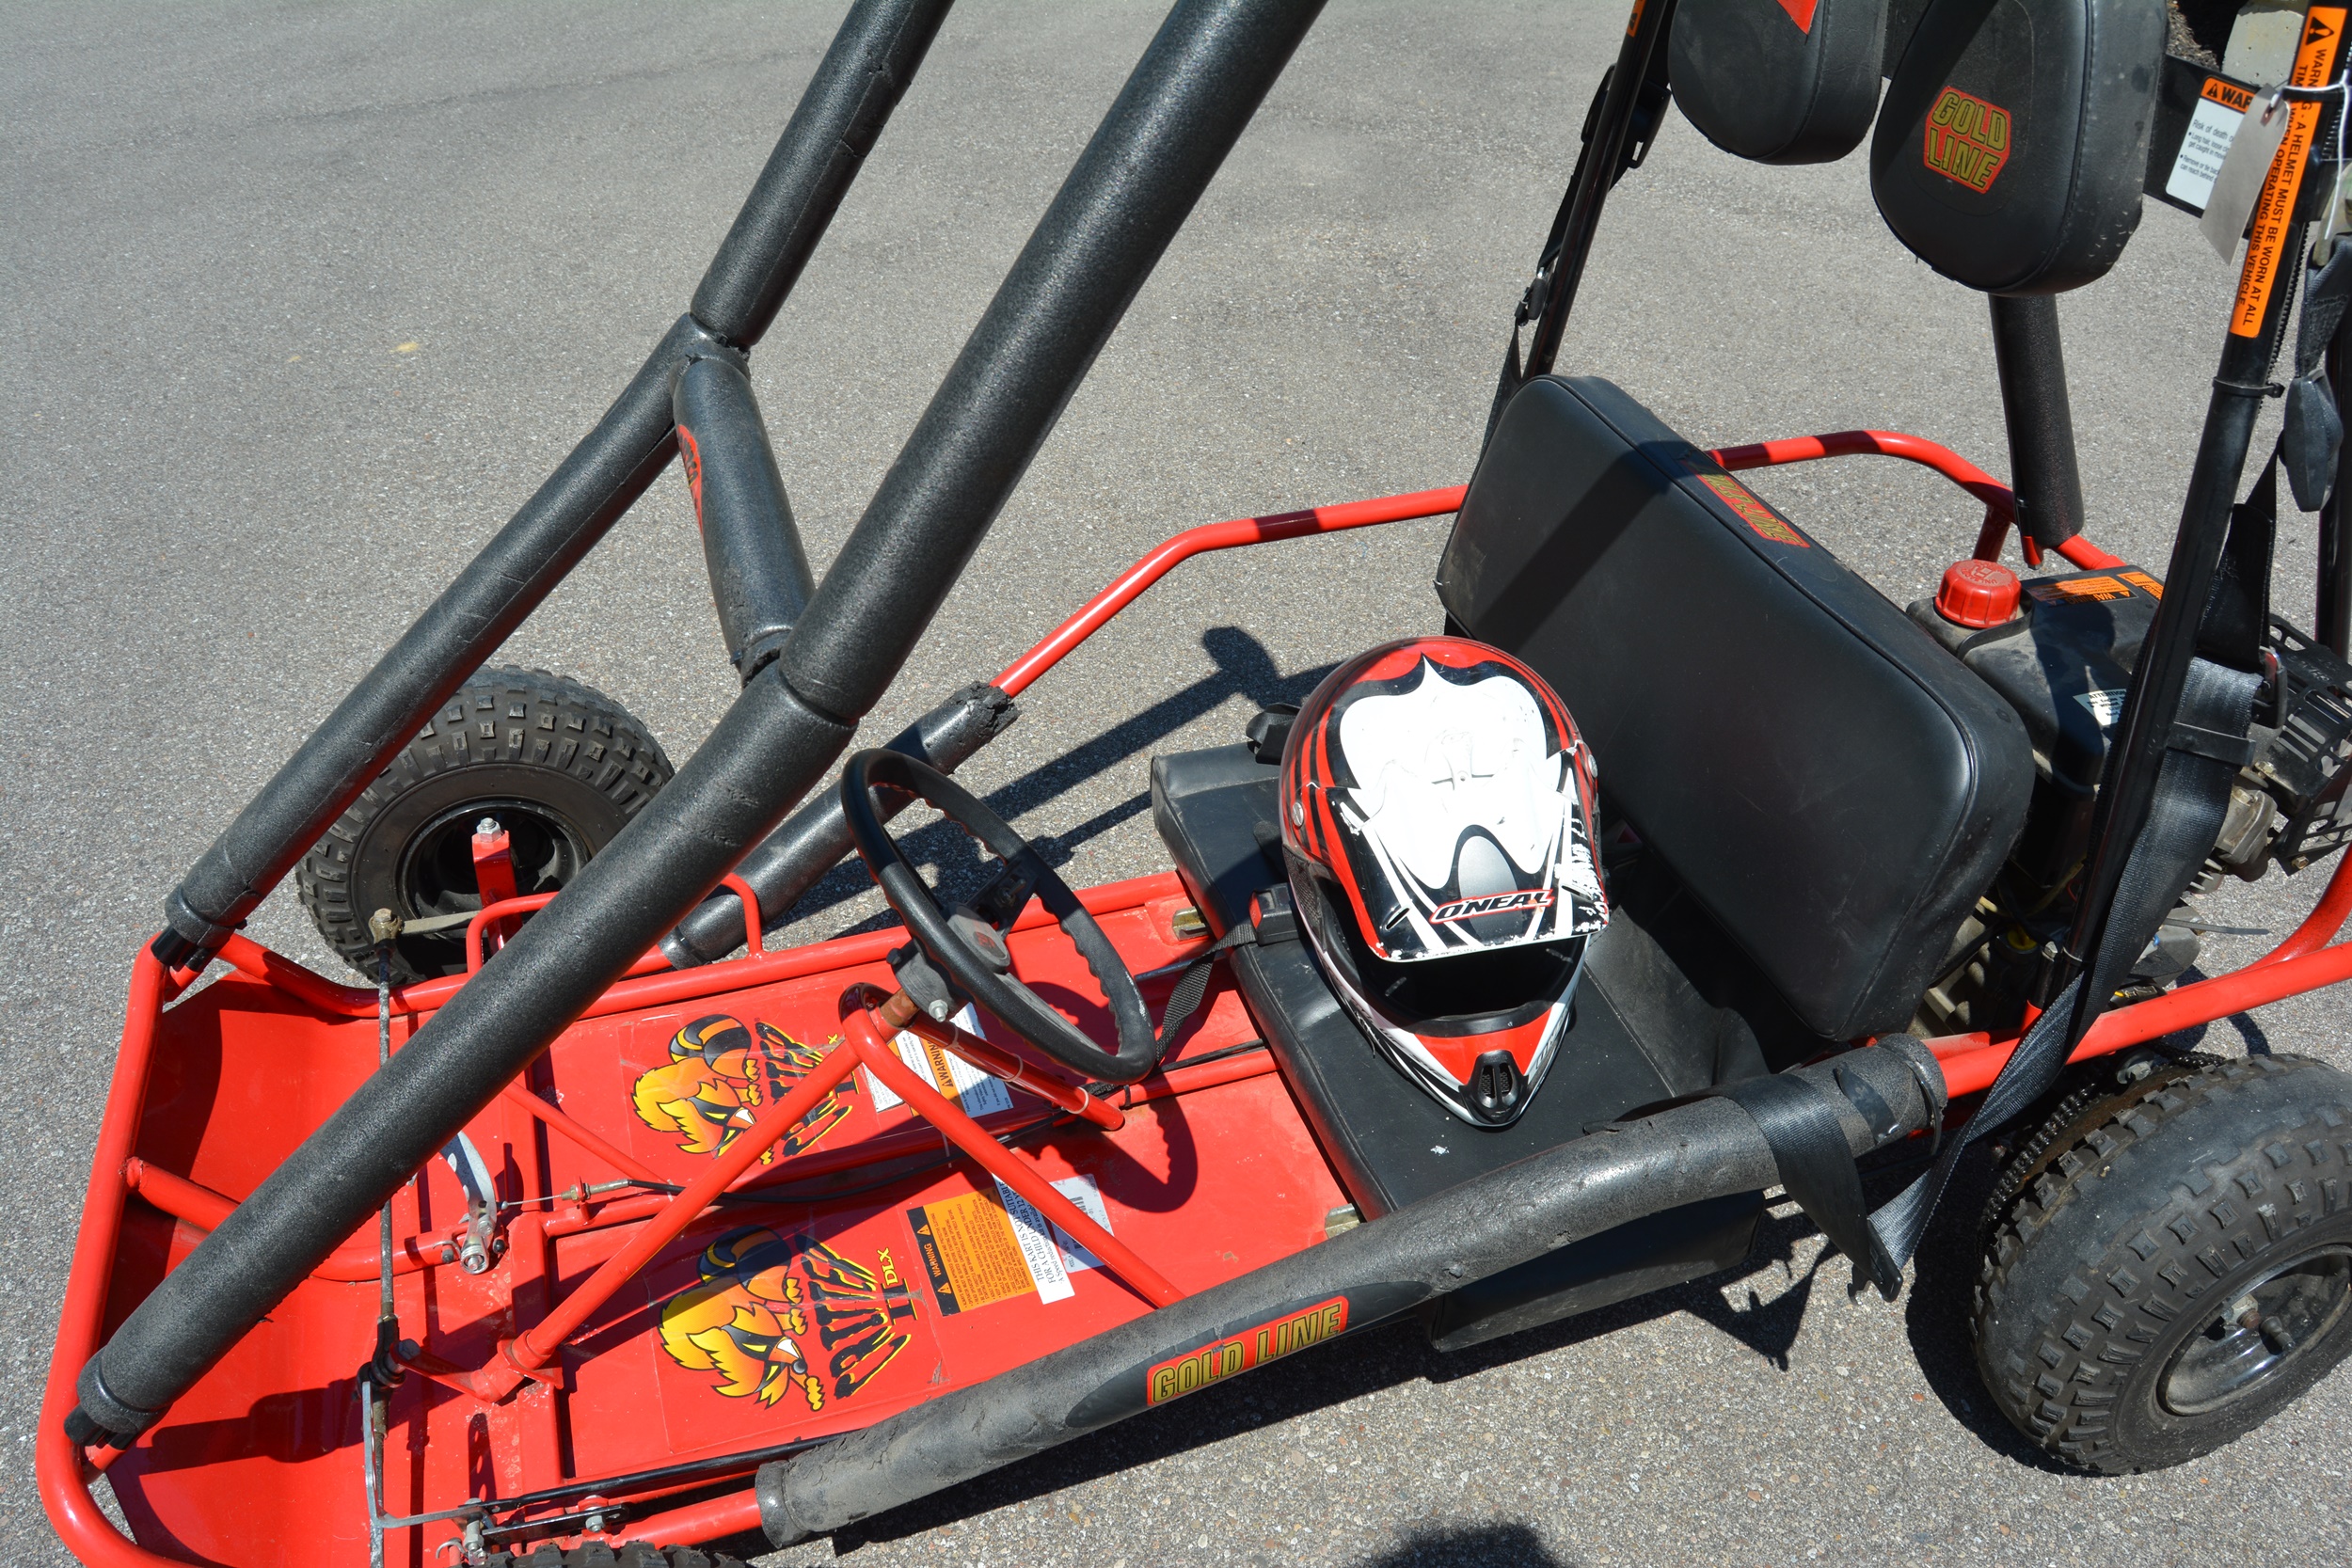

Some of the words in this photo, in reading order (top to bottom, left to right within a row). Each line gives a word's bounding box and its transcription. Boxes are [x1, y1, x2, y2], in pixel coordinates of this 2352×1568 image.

[2302, 48, 2328, 110] WARNG
[1931, 91, 2007, 151] GOLD
[2192, 119, 2204, 131] Risk
[2205, 125, 2213, 134] of
[2213, 128, 2228, 139] death
[2296, 121, 2306, 130] A
[1928, 126, 2000, 189] LINE
[2281, 133, 2304, 185] HELMET
[2259, 149, 2285, 219] OPERATING
[2271, 189, 2289, 224] MUST
[2251, 224, 2265, 251] THIS
[2265, 226, 2279, 244] BE
[2258, 246, 2274, 284] WORN
[2237, 254, 2256, 307] VEHICLE.
[2252, 286, 2262, 302] AT
[2243, 305, 2256, 326] ALL
[1732, 502, 1804, 545] LINE
[998, 1180, 1018, 1215] SUITABLE
[1015, 1198, 1025, 1207] 12
[1011, 1213, 1025, 1232] NOT
[1019, 1206, 1036, 1234] UNDER
[1036, 1226, 1045, 1236] kit
[1018, 1231, 1028, 1241] IS
[1029, 1234, 1046, 1259] CHILD
[1041, 1235, 1056, 1260] reduction
[924, 1243, 942, 1277] WARNING
[1022, 1241, 1037, 1262] KART
[877, 1247, 898, 1286] DLX
[1030, 1262, 1044, 1281] THIS
[1042, 1266, 1056, 1283] FOR
[1050, 1259, 1064, 1276] Speed
[881, 1277, 918, 1325] II
[794, 1234, 912, 1400] CRITTER
[1152, 1340, 1245, 1404] GOLD
[1255, 1301, 1343, 1365] LINE
